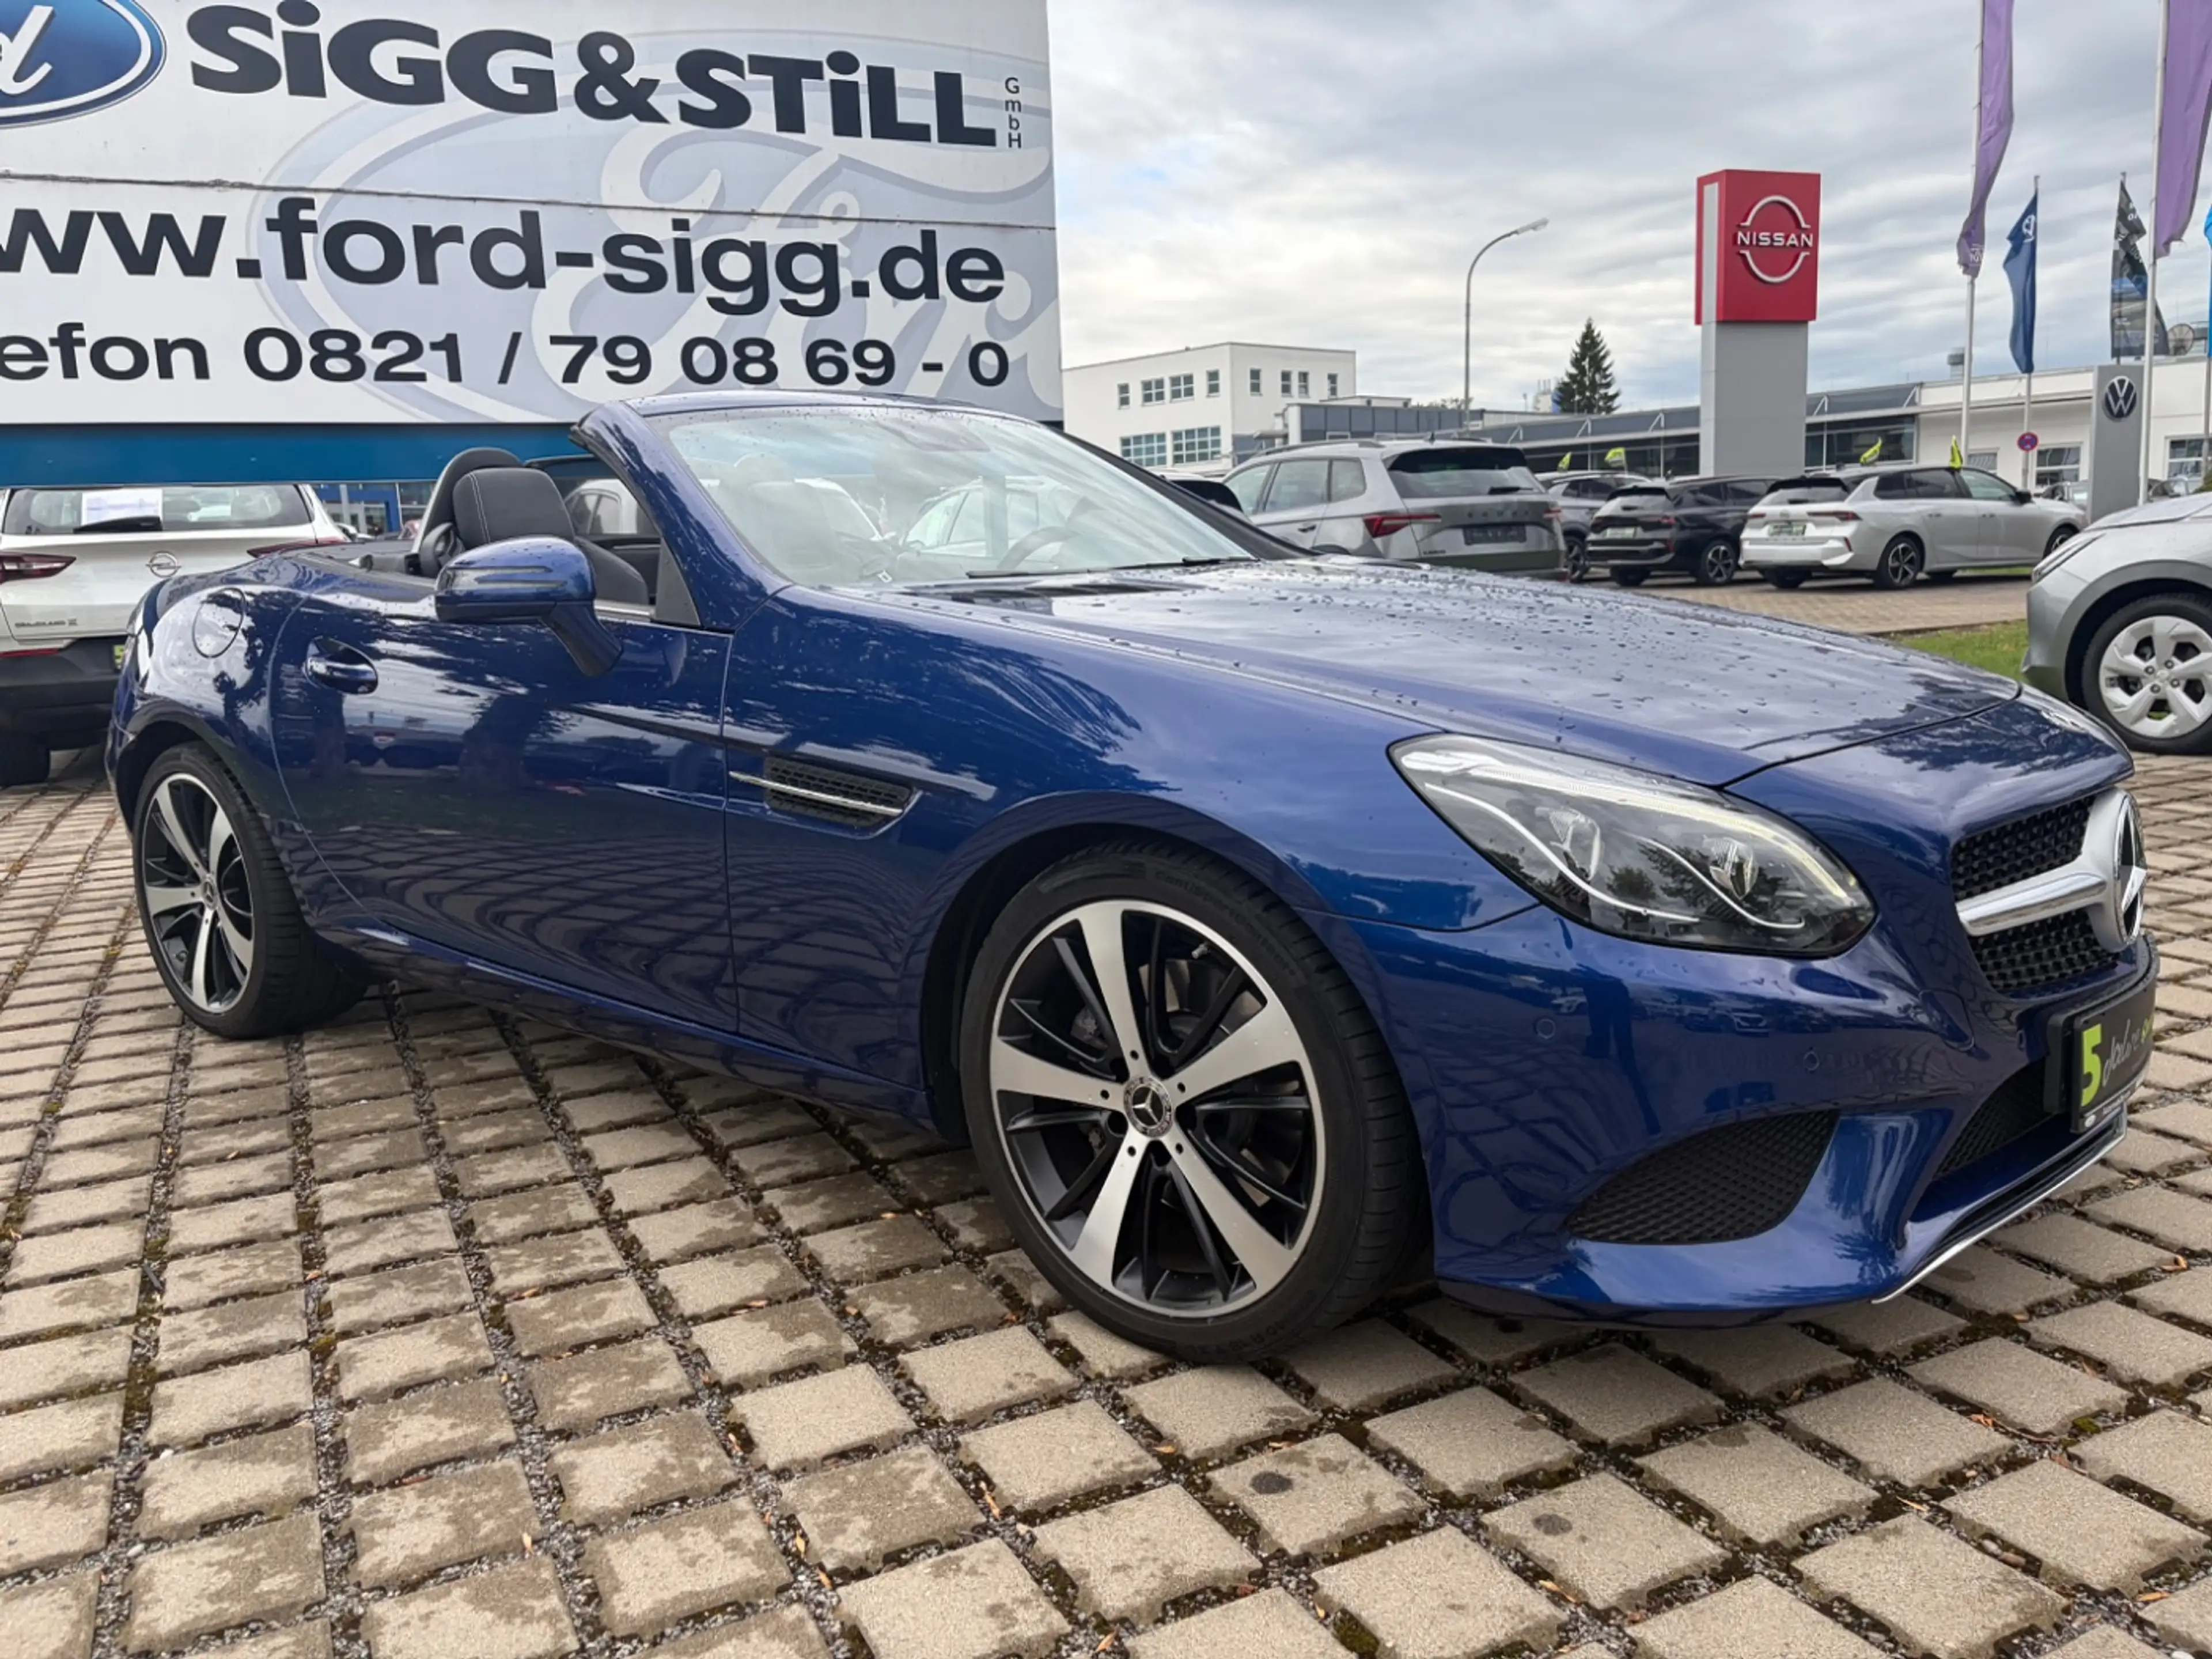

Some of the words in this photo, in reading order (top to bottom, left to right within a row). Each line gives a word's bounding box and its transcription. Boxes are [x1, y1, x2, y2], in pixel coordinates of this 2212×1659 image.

[1004, 77, 1021, 149] GmbH
[1736, 230, 1814, 248] NISSAN
[244, 327, 463, 383] 0821
[550, 335, 652, 385] 79
[681, 336, 778, 386] 08
[805, 338, 896, 387] 69
[968, 341, 1009, 387] 0
